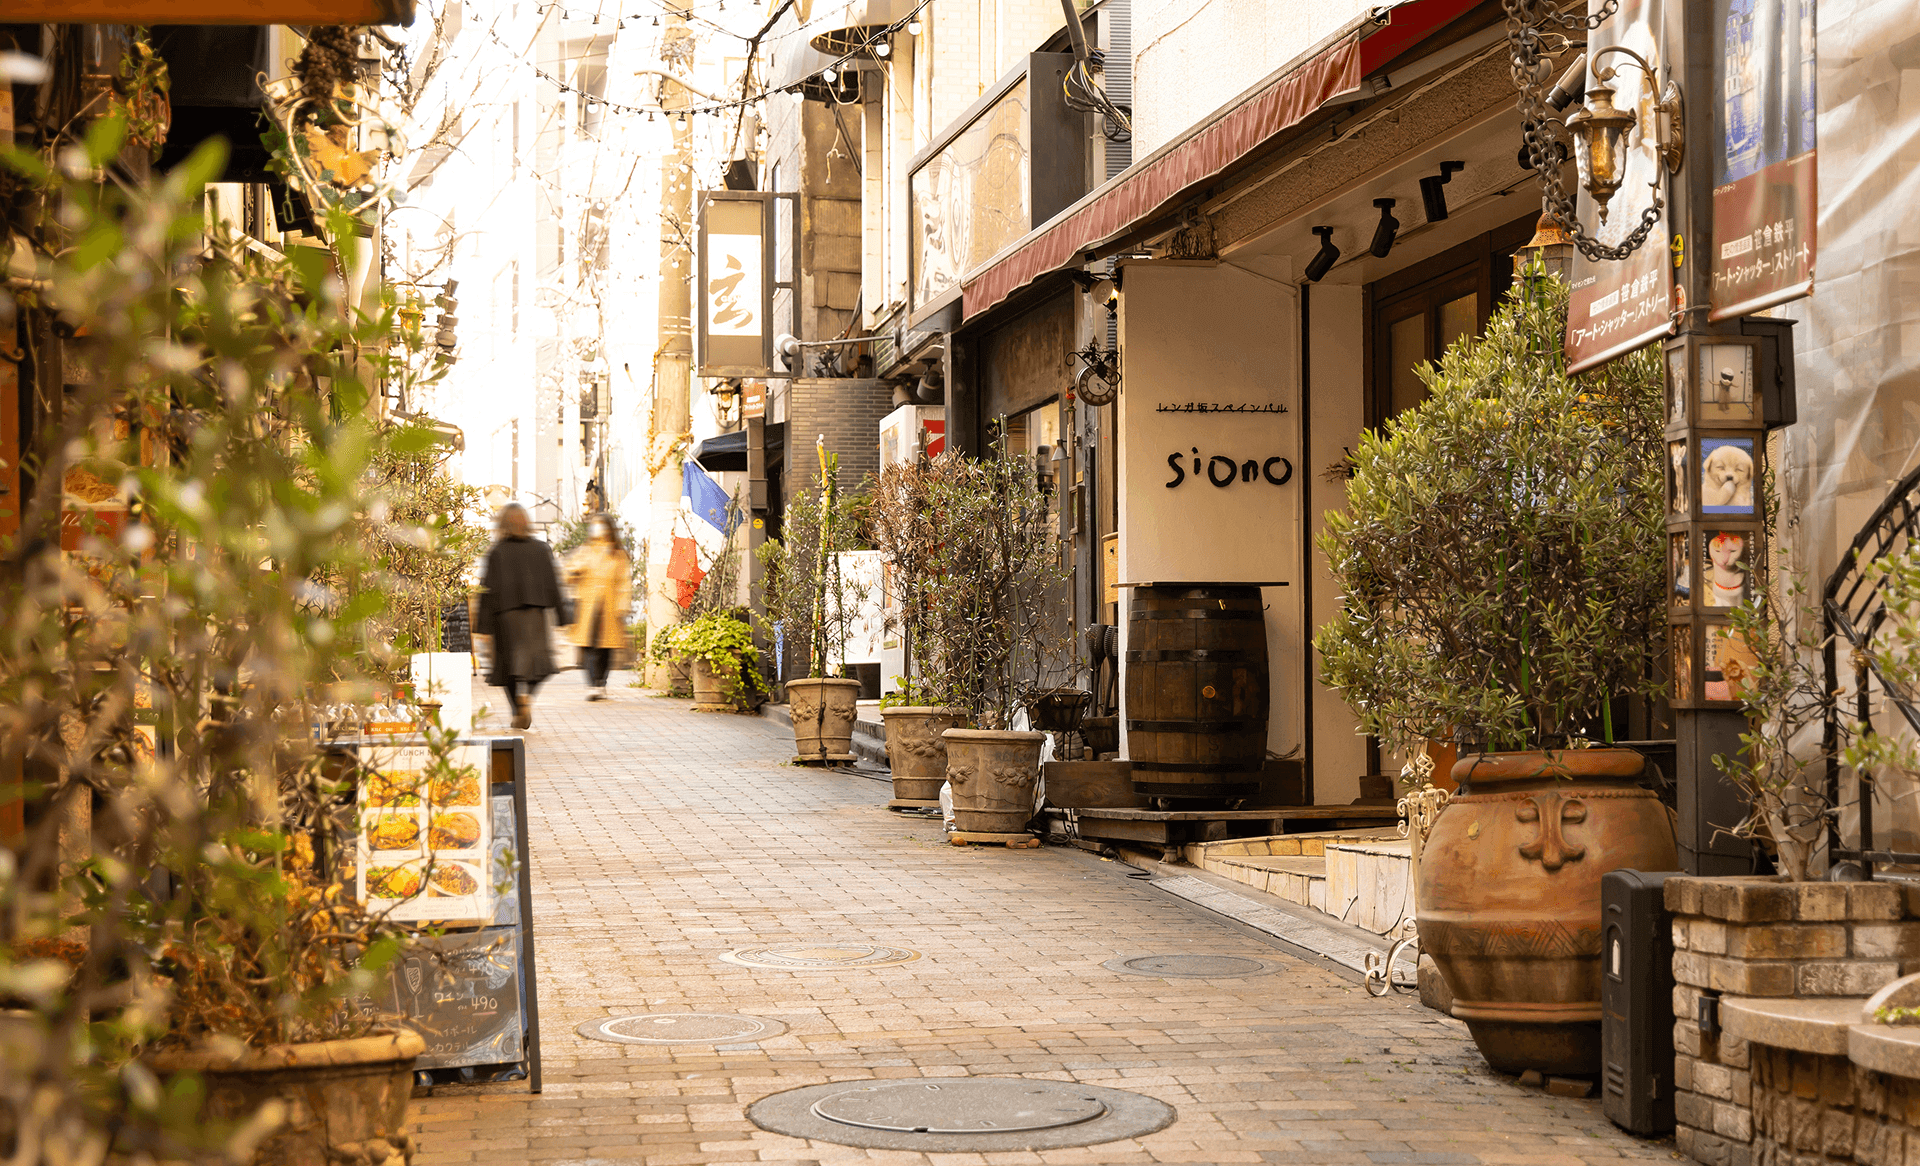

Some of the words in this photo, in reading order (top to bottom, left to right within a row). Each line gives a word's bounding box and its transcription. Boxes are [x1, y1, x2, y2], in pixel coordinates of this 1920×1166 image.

[1753, 217, 1795, 251] 笹倉鉄平
[1620, 268, 1659, 304] 笹倉鉄平
[399, 749, 425, 757] LUNCH
[434, 991, 464, 1003] ワイン
[472, 996, 498, 1010] 490
